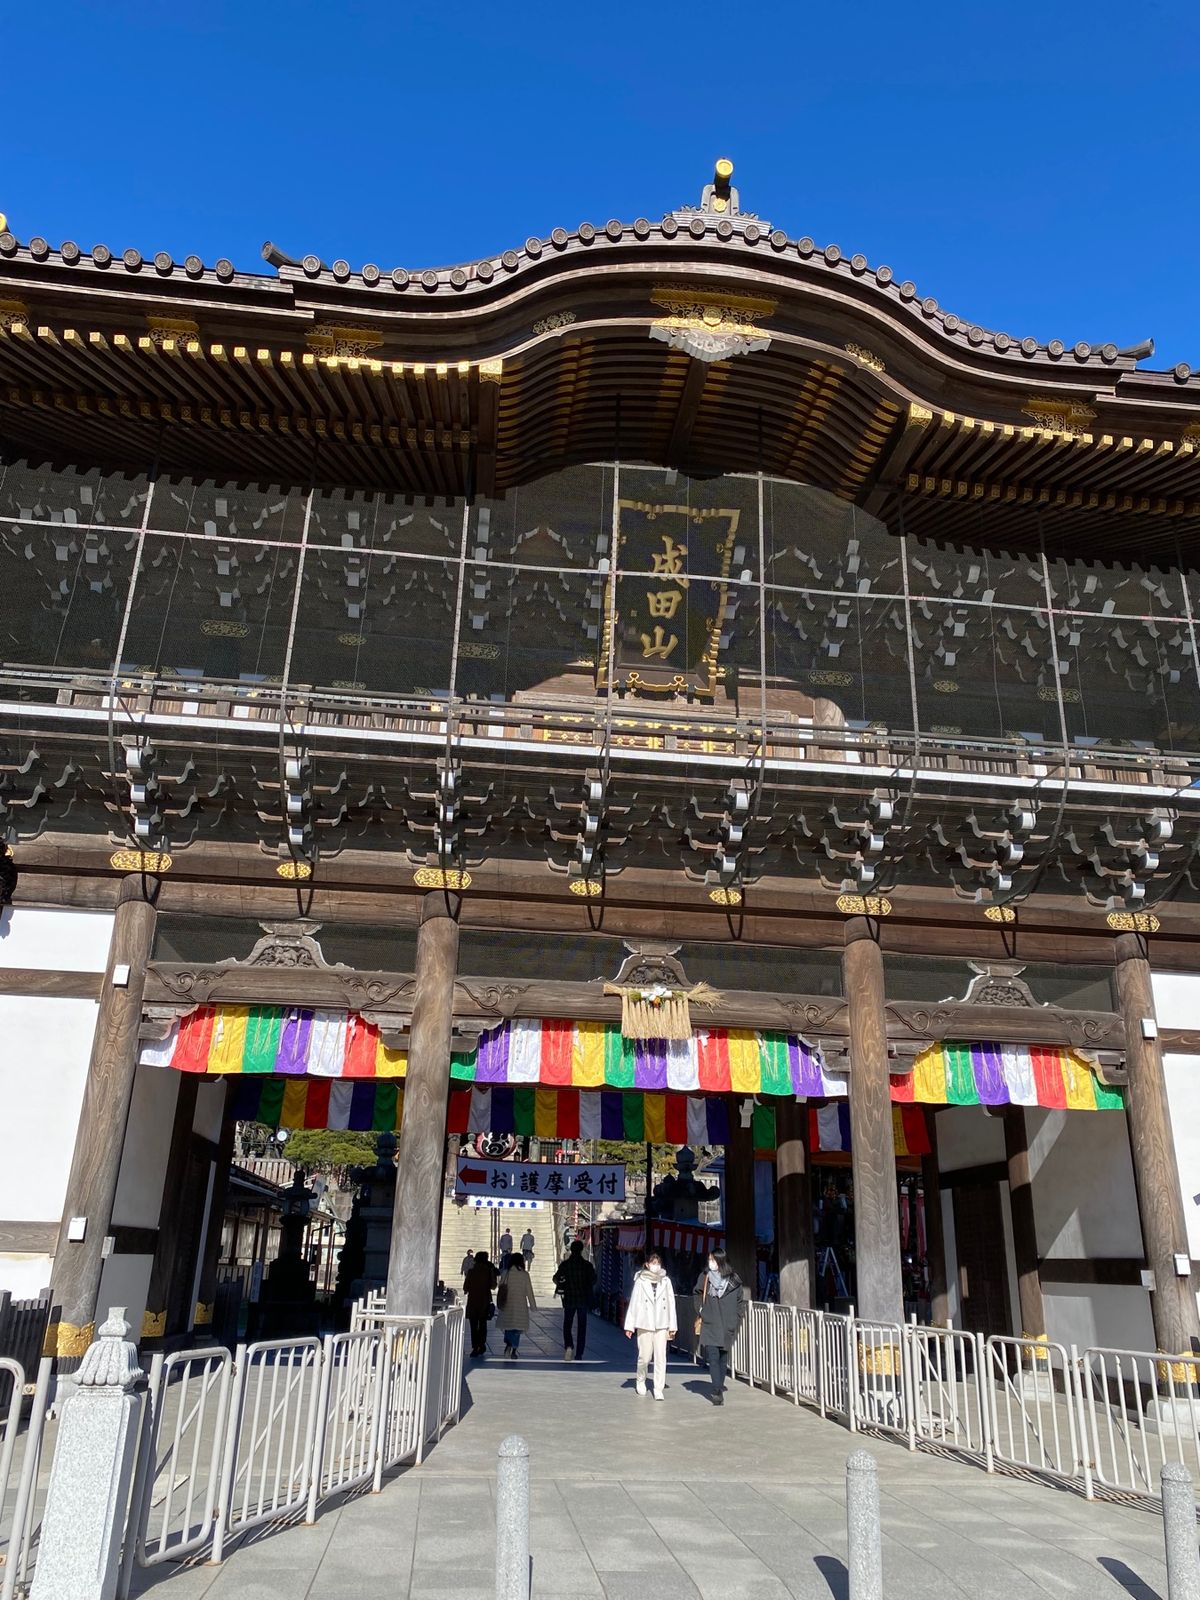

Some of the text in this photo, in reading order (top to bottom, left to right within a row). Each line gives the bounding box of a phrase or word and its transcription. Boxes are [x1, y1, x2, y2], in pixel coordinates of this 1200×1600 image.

[640, 535, 690, 659] 成田山
[490, 1169, 618, 1195] お護摩受付
